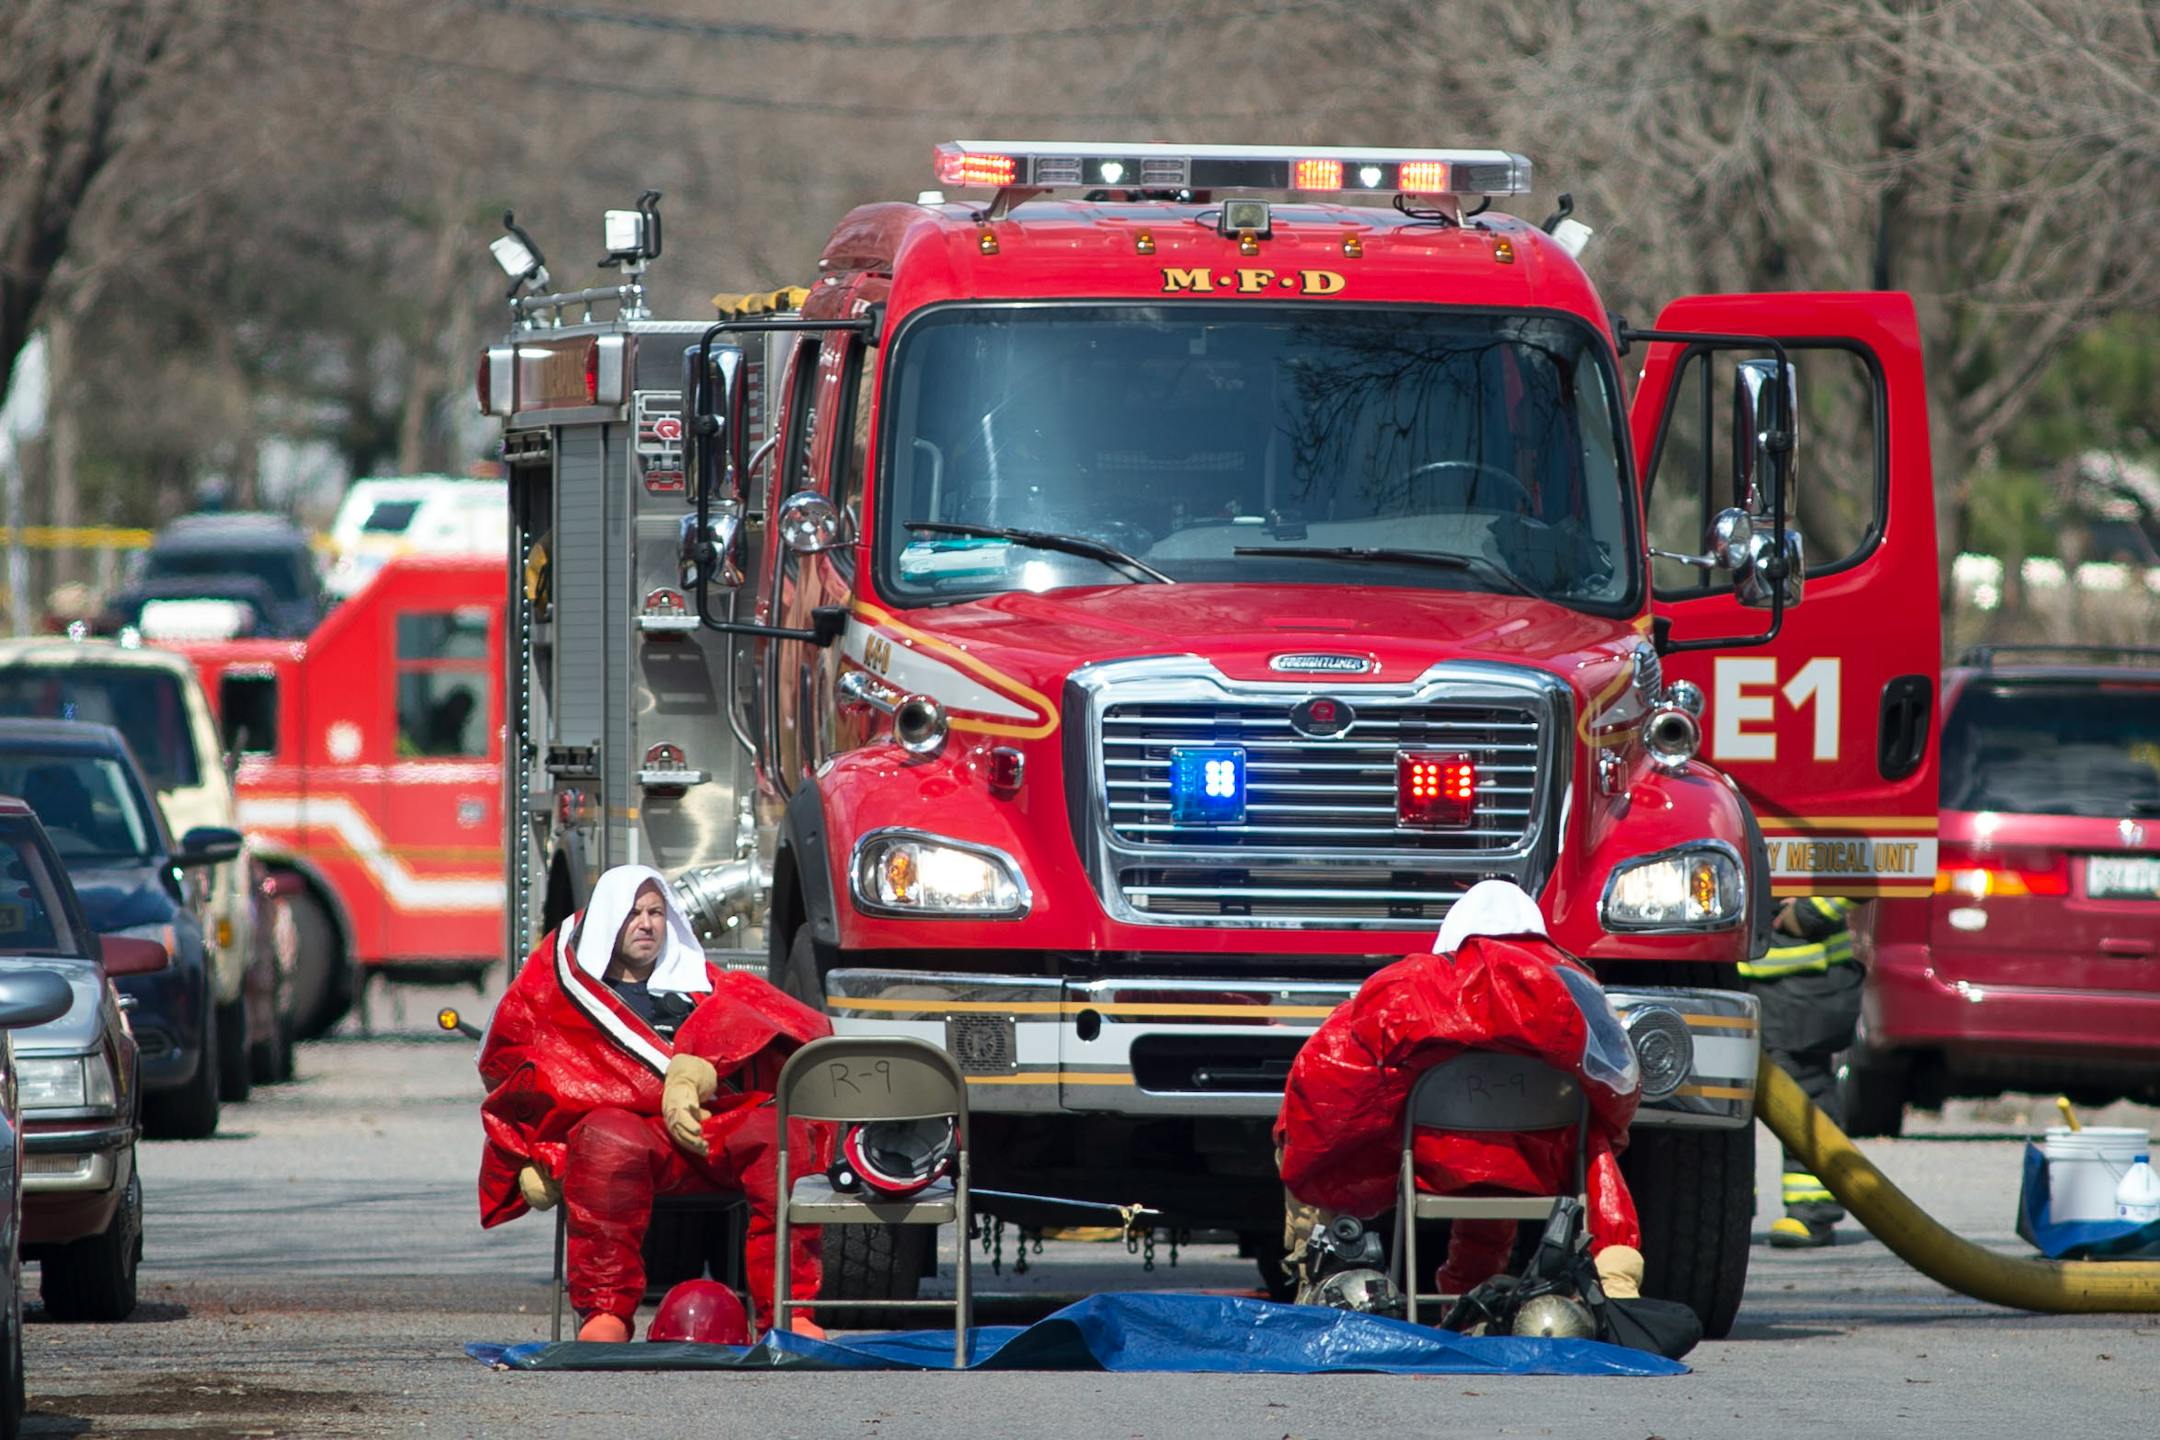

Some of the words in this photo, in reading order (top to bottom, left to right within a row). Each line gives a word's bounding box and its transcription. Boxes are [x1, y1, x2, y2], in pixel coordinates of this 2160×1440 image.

[1712, 656, 1842, 763] E1
[1786, 841, 1869, 872] MEDICAL
[1874, 842, 1918, 873] UNIT
[829, 1060, 892, 1098] R-9
[1465, 1073, 1526, 1103] R-9
